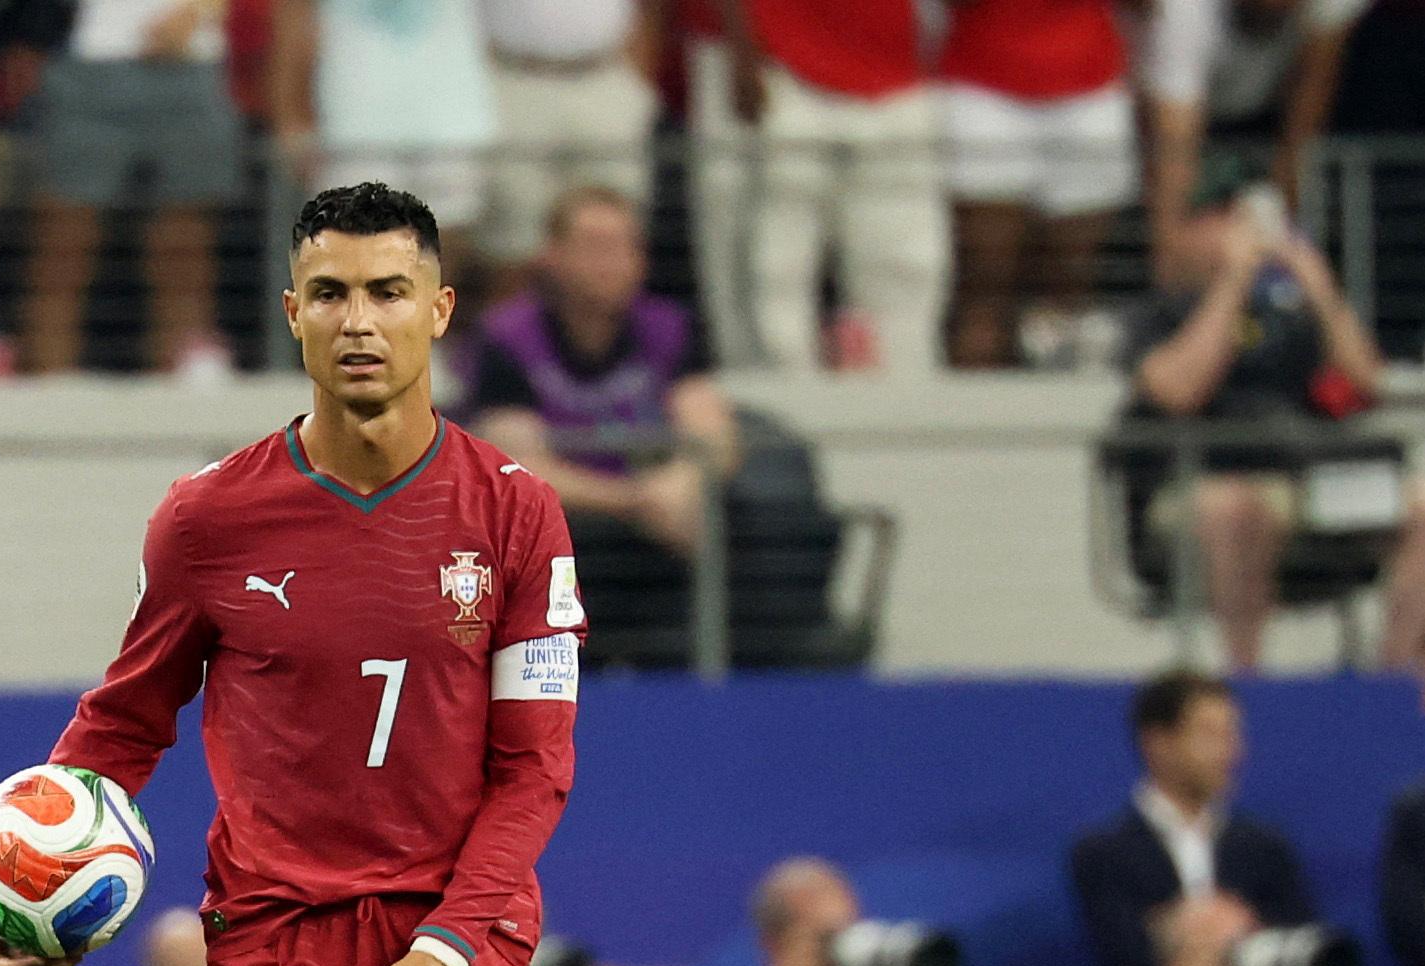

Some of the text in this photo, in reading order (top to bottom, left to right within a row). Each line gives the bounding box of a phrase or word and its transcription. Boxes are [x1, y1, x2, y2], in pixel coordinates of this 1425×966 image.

[525, 648, 574, 666] UNITES
[521, 665, 545, 681] the
[361, 658, 408, 768] 7
